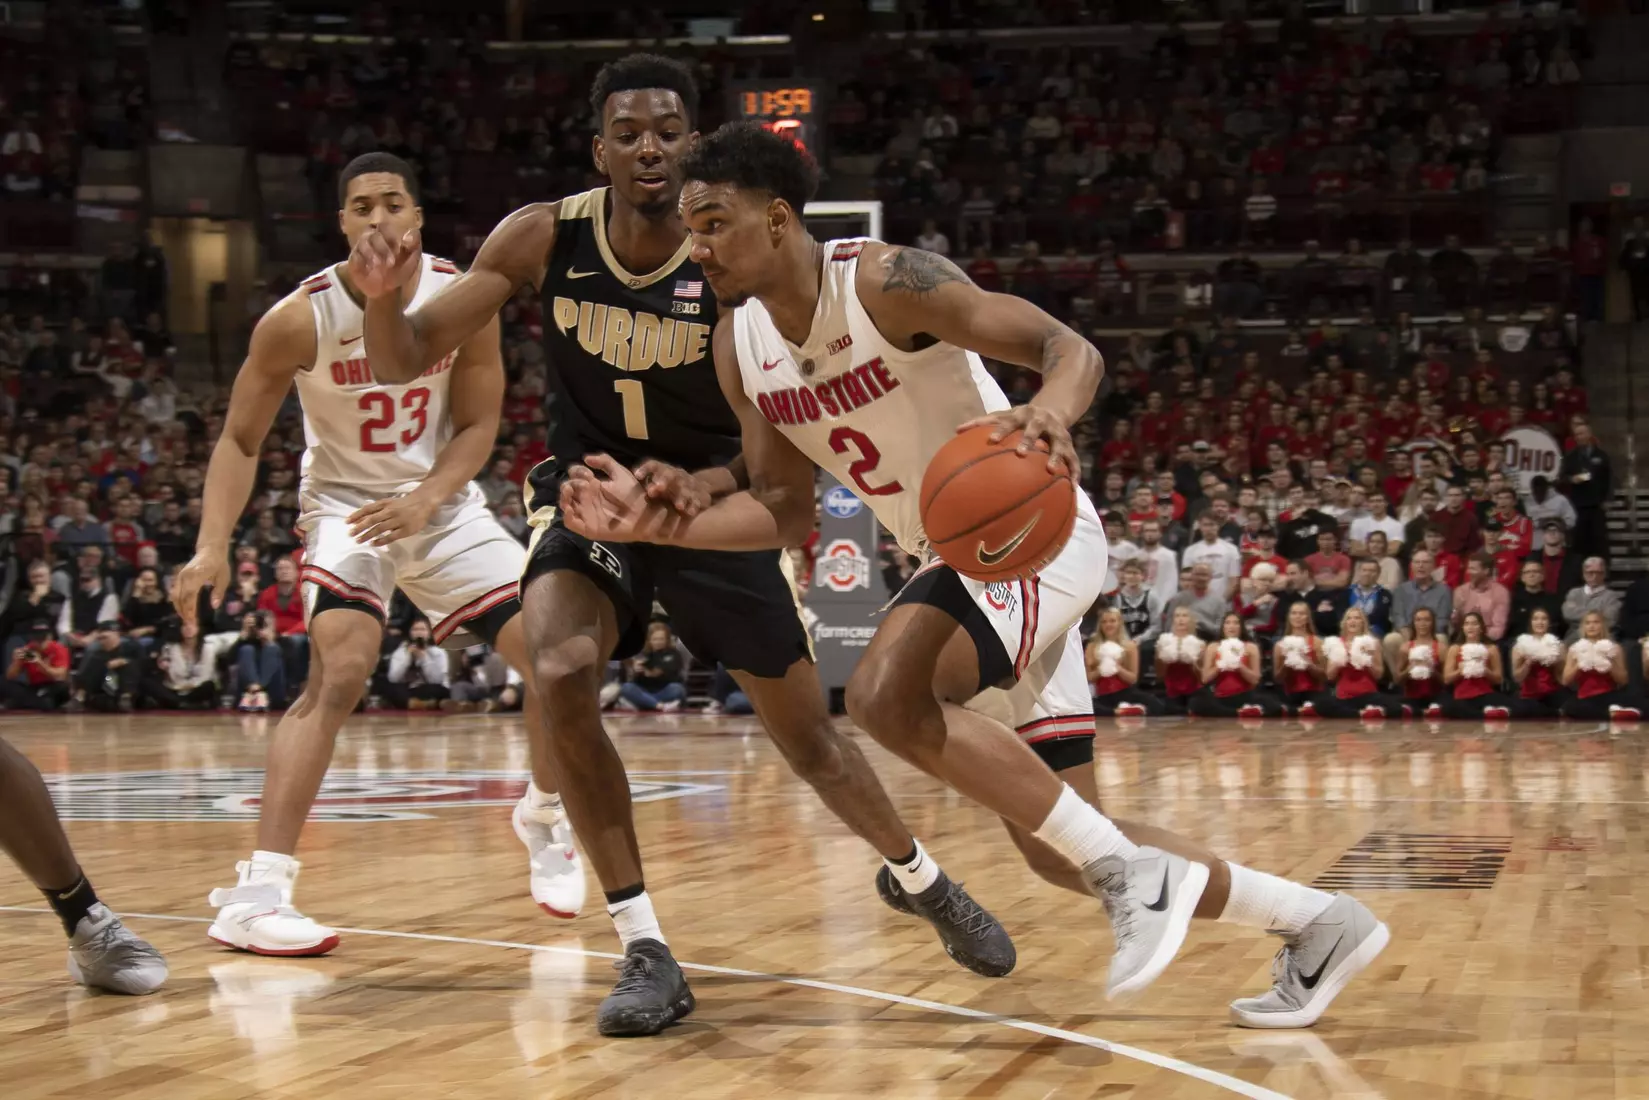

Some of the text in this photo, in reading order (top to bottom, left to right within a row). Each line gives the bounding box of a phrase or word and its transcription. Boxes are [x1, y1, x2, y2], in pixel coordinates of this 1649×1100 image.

[553, 296, 711, 371] PURDUE
[329, 357, 372, 386] OHI
[756, 355, 901, 426] OHIO STATE
[358, 386, 431, 453] 23
[613, 378, 649, 440] 1
[827, 425, 905, 497] 2
[1504, 438, 1556, 472] OHIO
[815, 622, 877, 642] farmCRE
[994, 581, 1018, 622] STATE
